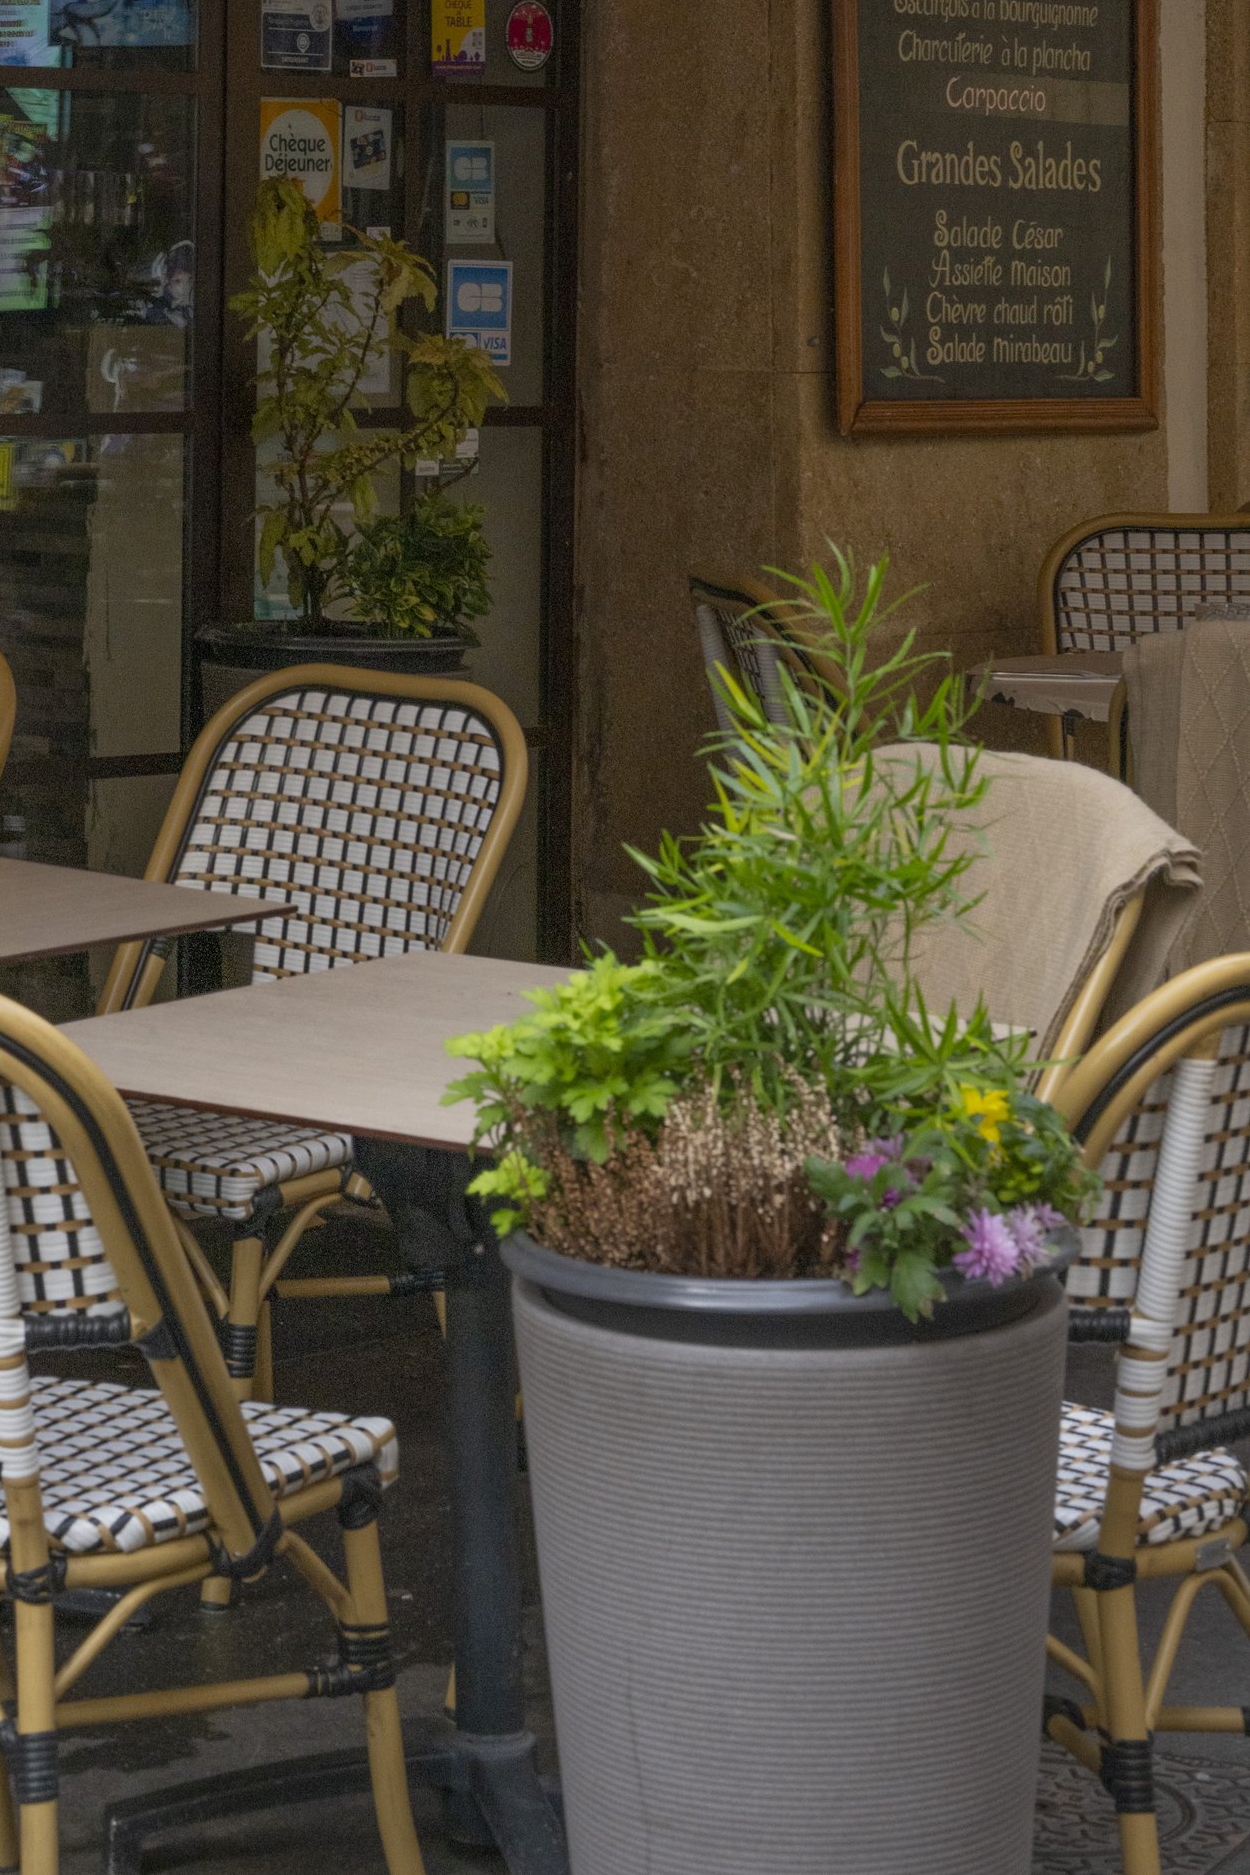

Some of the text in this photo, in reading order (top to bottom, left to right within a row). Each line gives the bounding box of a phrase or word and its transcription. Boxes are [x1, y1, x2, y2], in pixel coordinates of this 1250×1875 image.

[445, 16, 472, 28] TABLE
[897, 29, 1091, 76] Charcuterie à la plancha
[945, 75, 1046, 116] Carpaccio
[269, 133, 326, 155] Chèque
[265, 153, 331, 175] Déjeuner
[896, 139, 1102, 192] Grandes Salades
[933, 209, 1064, 250] Salade César
[928, 249, 1003, 288] Assiette
[925, 290, 1074, 325] Chèvre chaud rôti
[483, 337, 507, 350] VISA
[926, 325, 986, 365] Salade
